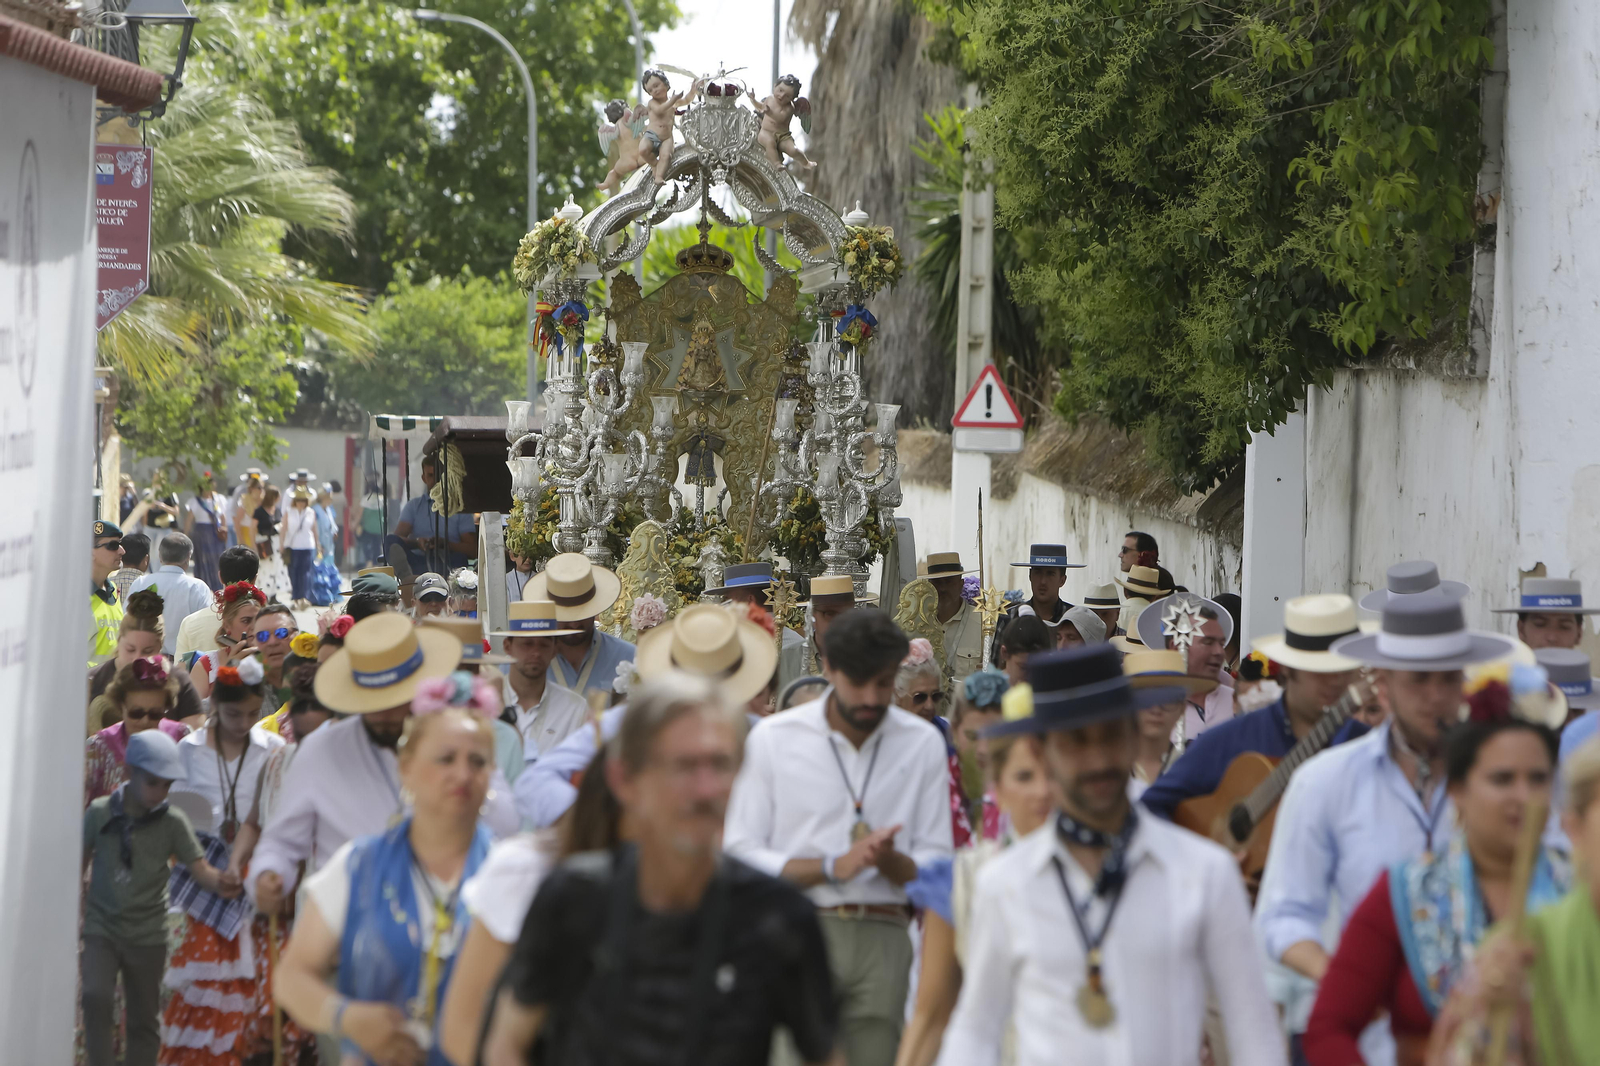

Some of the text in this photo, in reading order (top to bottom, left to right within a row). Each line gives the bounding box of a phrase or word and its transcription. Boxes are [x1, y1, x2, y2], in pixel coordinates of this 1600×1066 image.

[96, 198, 138, 208] DE INTERÉS
[117, 208, 128, 217] DE
[97, 246, 120, 254] ANRIQUE
[98, 262, 142, 270] RMANDADES
[1538, 596, 1573, 606] MORÓN
[520, 620, 550, 629] MORÓN
